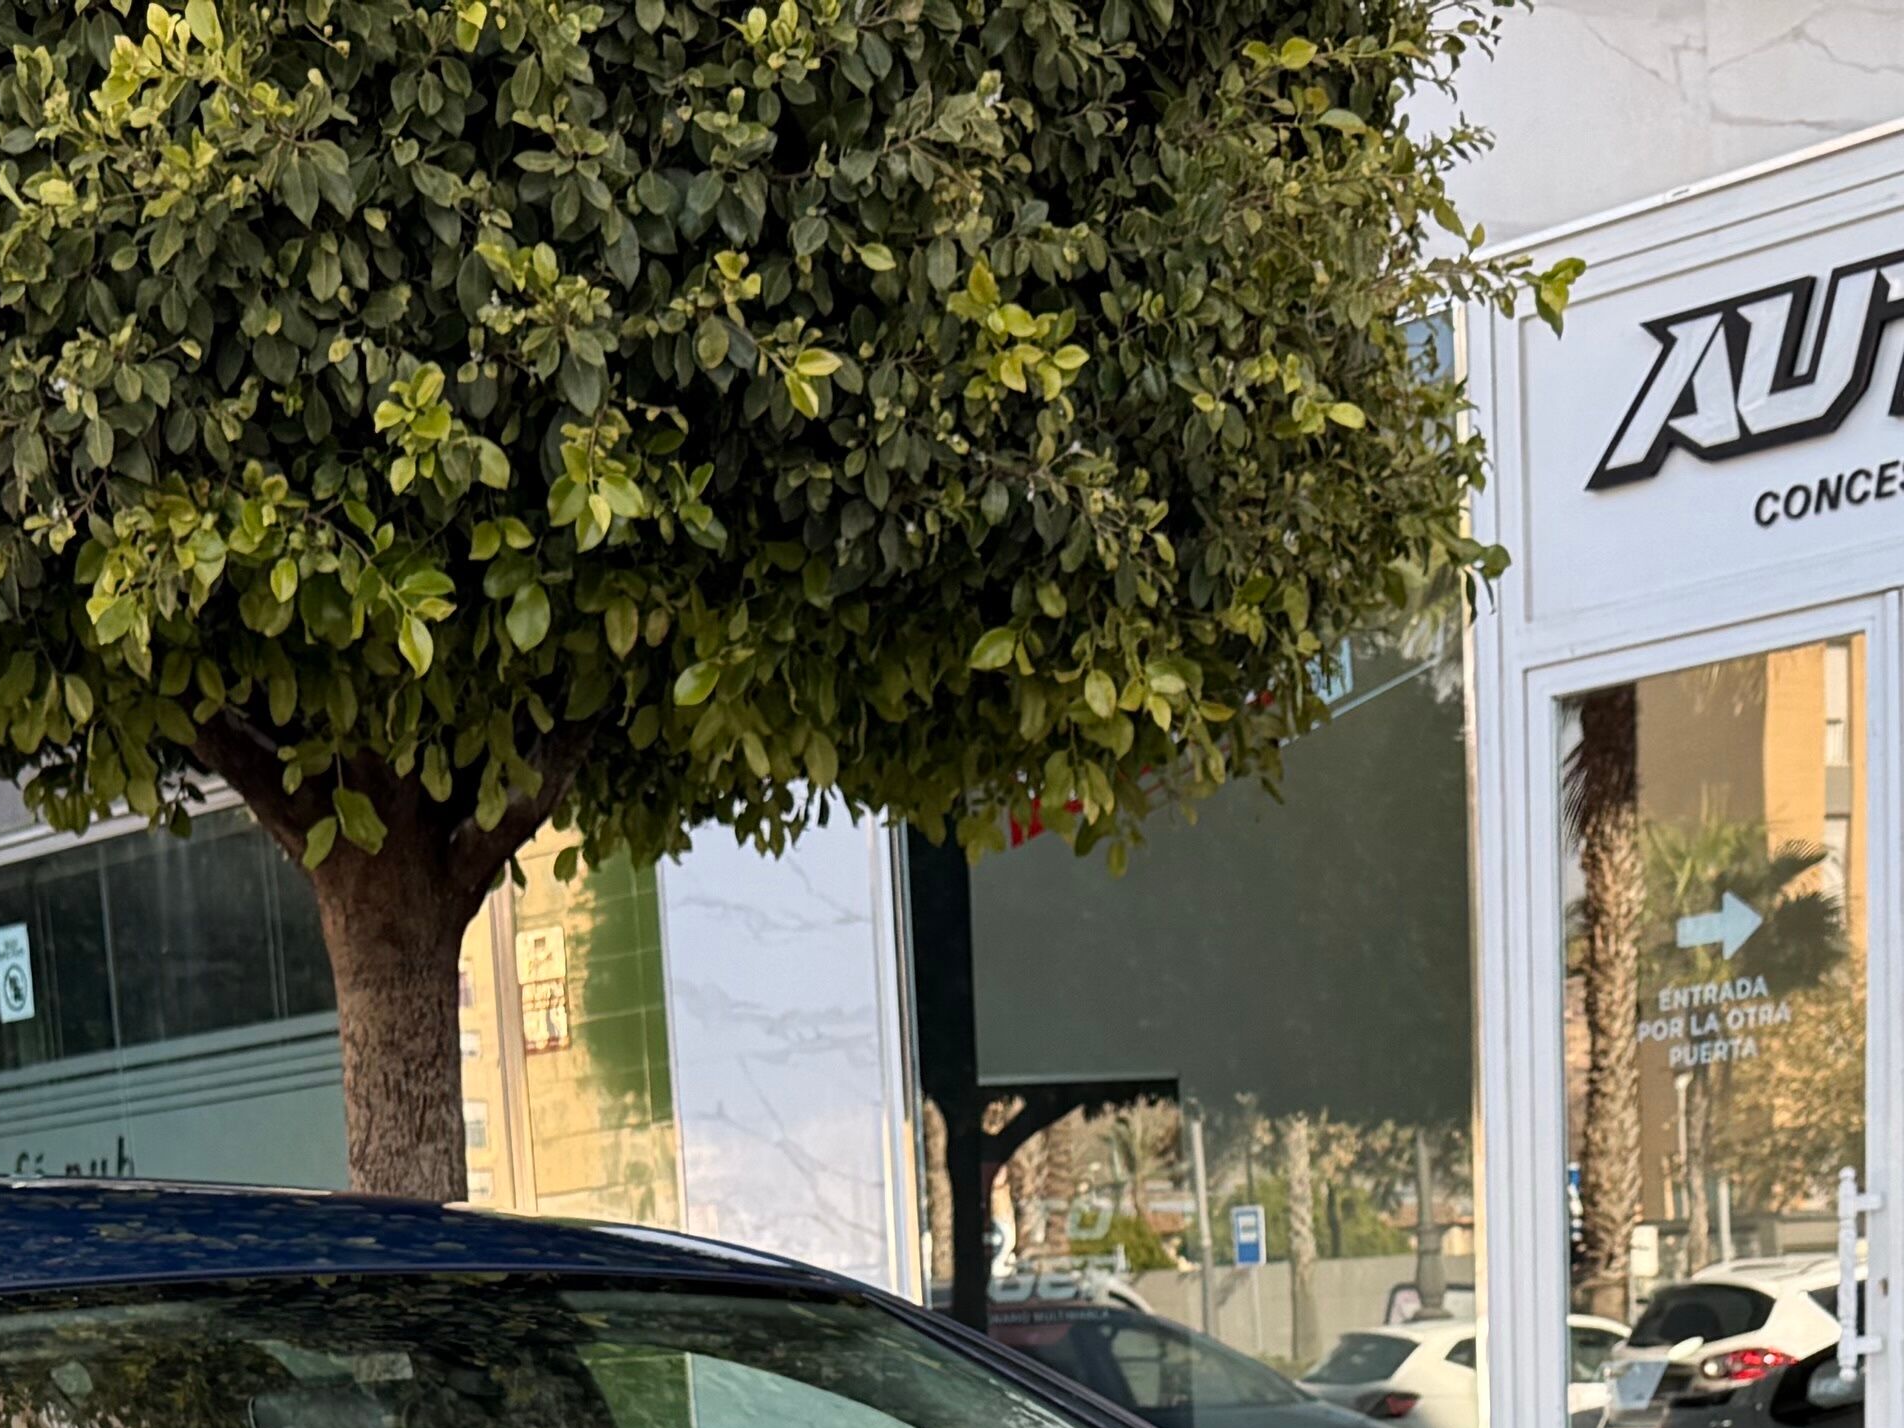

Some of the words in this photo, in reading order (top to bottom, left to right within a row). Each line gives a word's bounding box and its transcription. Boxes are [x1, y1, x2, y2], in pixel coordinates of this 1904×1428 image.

[1658, 974, 1769, 1012] ENTRADA
[1637, 1016, 1685, 1043] POR
[1690, 1012, 1720, 1036] LA
[1726, 1001, 1792, 1030] OTRA
[1668, 1037, 1759, 1068] PUERTA
